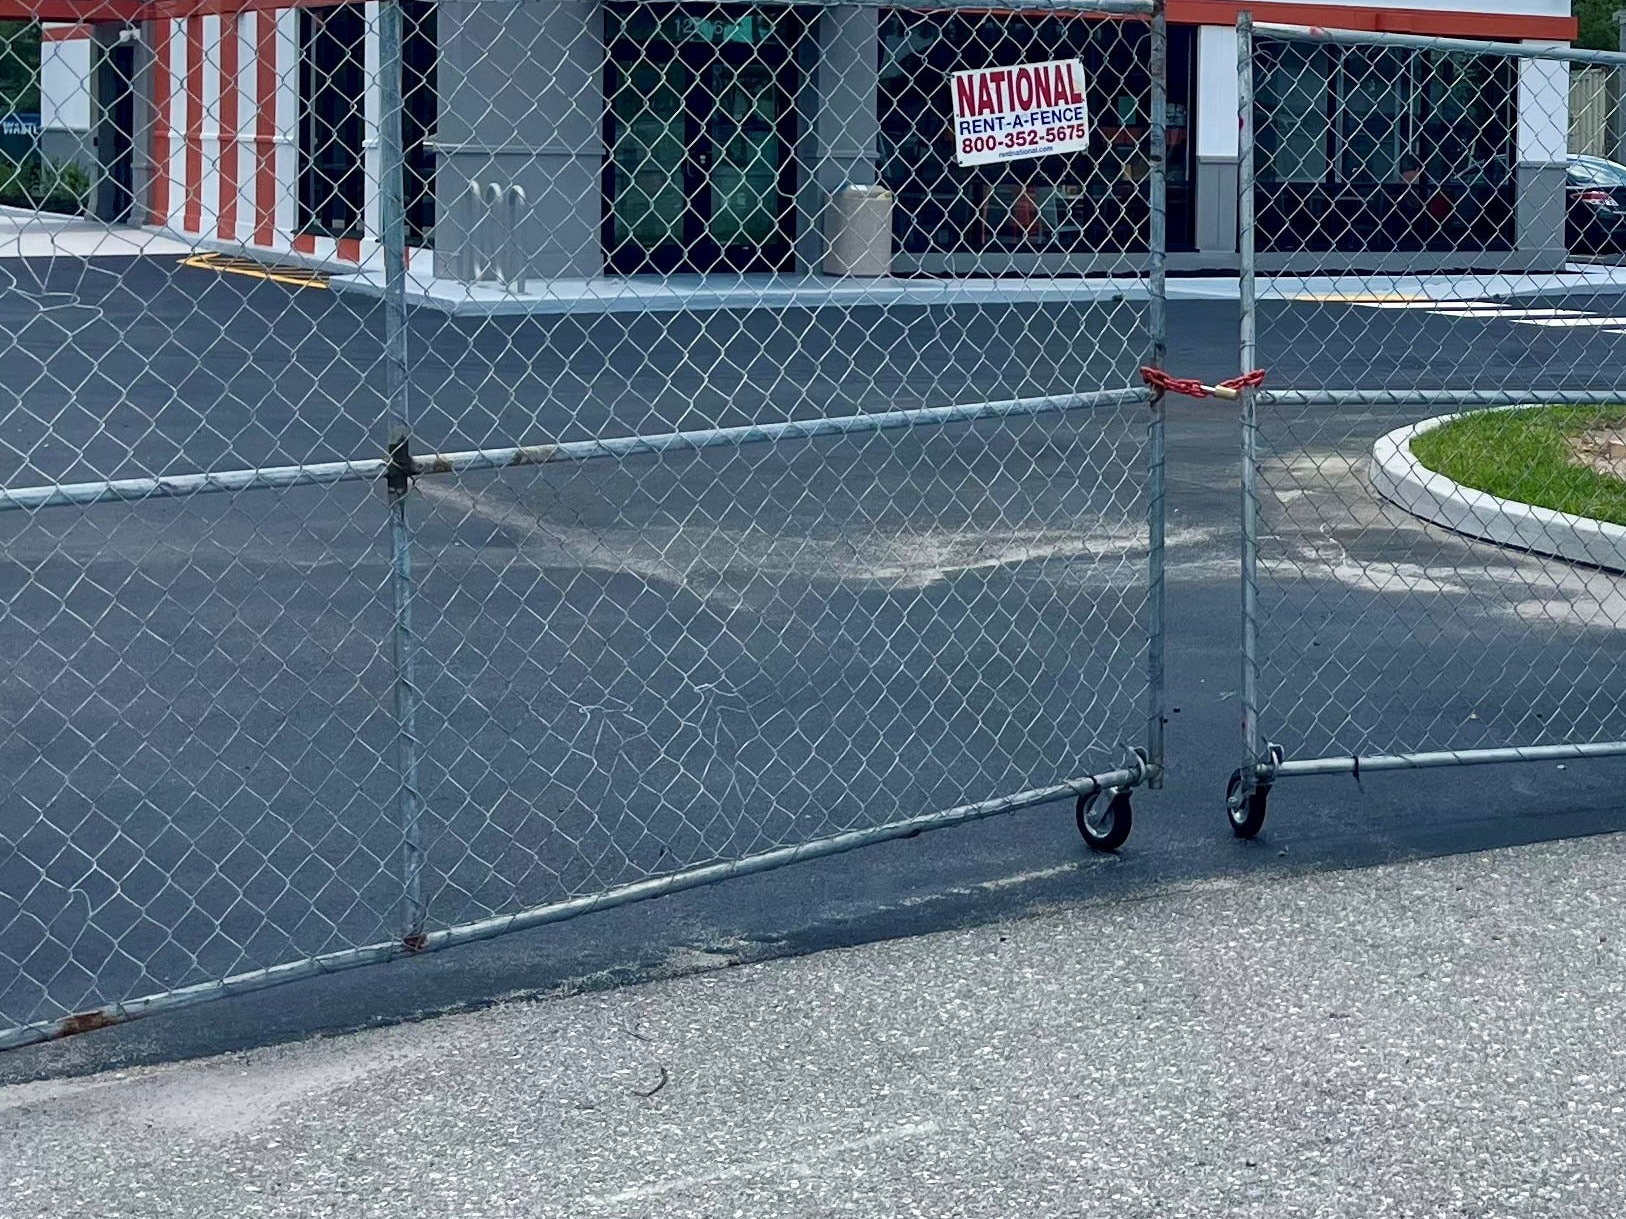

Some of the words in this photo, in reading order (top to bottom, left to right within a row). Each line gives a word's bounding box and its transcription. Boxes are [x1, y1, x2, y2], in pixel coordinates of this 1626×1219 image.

[956, 64, 1084, 118] NATIONAL
[960, 106, 1084, 135] RENT-A-FENCE
[962, 123, 1086, 154] 800-352-5675
